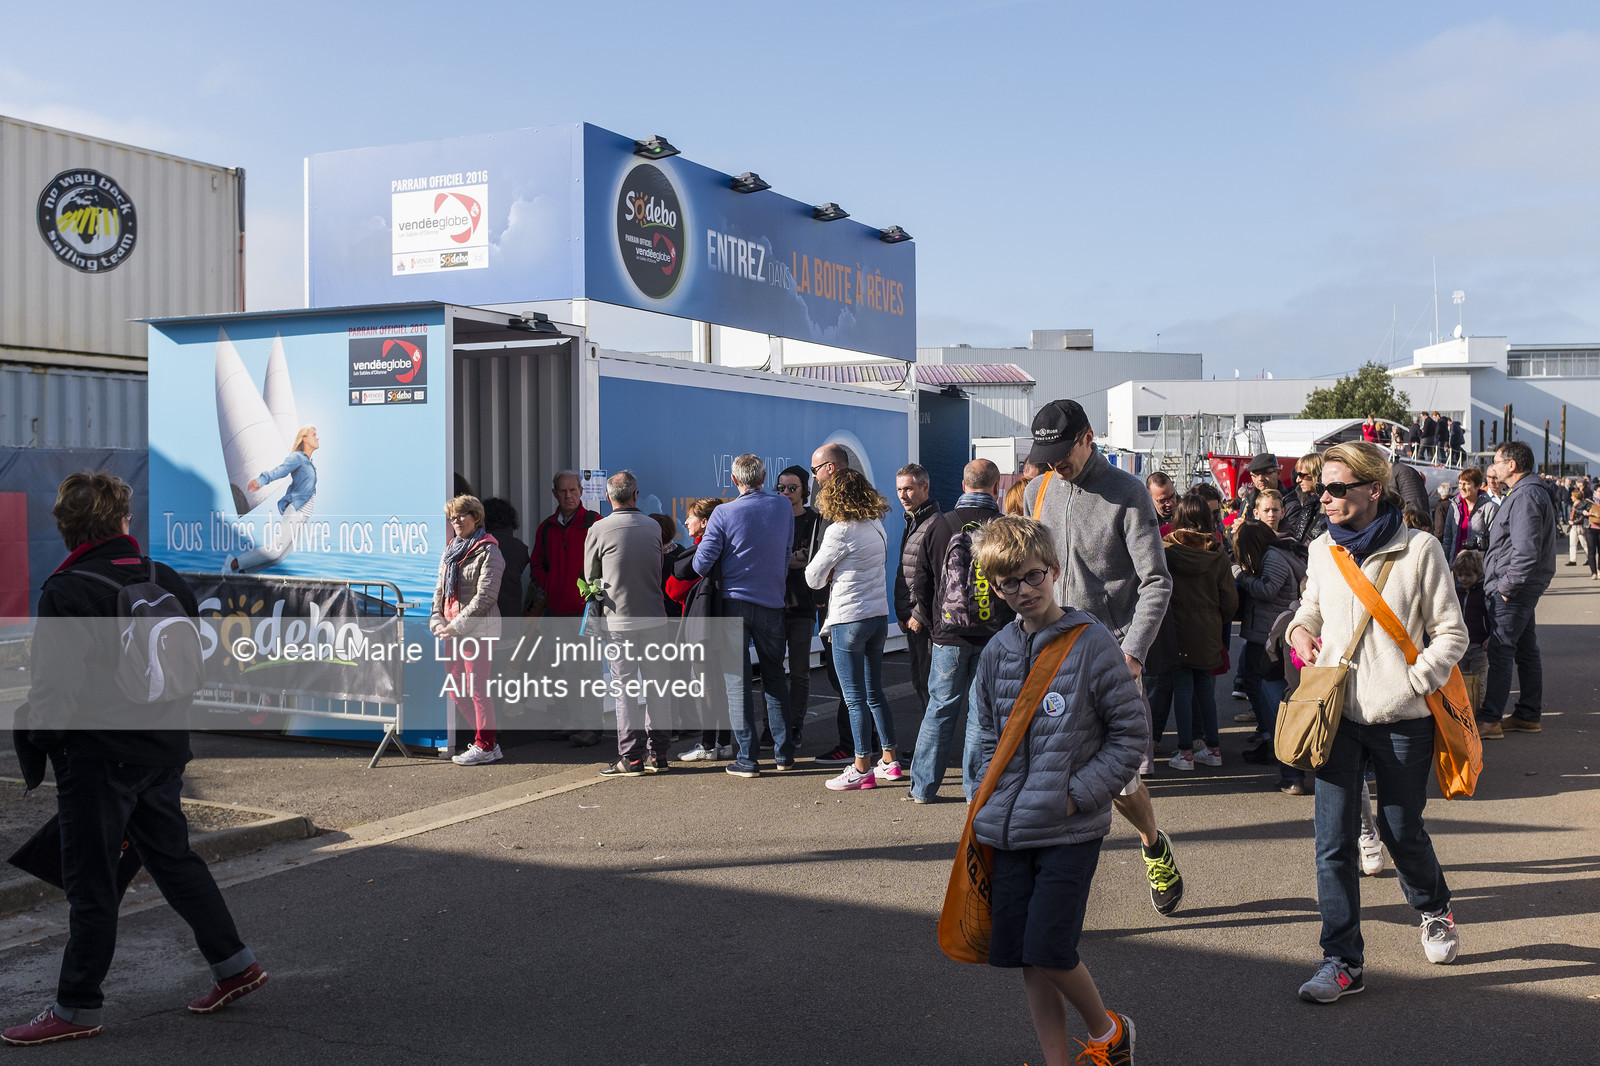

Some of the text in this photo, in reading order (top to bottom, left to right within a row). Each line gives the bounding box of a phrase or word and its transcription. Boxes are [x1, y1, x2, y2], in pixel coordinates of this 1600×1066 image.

[44, 174, 131, 215] no way back
[392, 170, 488, 192] PARRAIN OFFICIEL 2016
[47, 230, 134, 271] sailing team
[707, 229, 766, 283] ENTREZ
[768, 262, 790, 290] DANS
[793, 251, 811, 295] LA
[814, 258, 852, 305] BOITE
[867, 269, 904, 317] RÊVES
[348, 323, 428, 337] PARRAIN OFFICIEL 2016
[163, 510, 428, 555] Tous libres de vivre nos rêves
